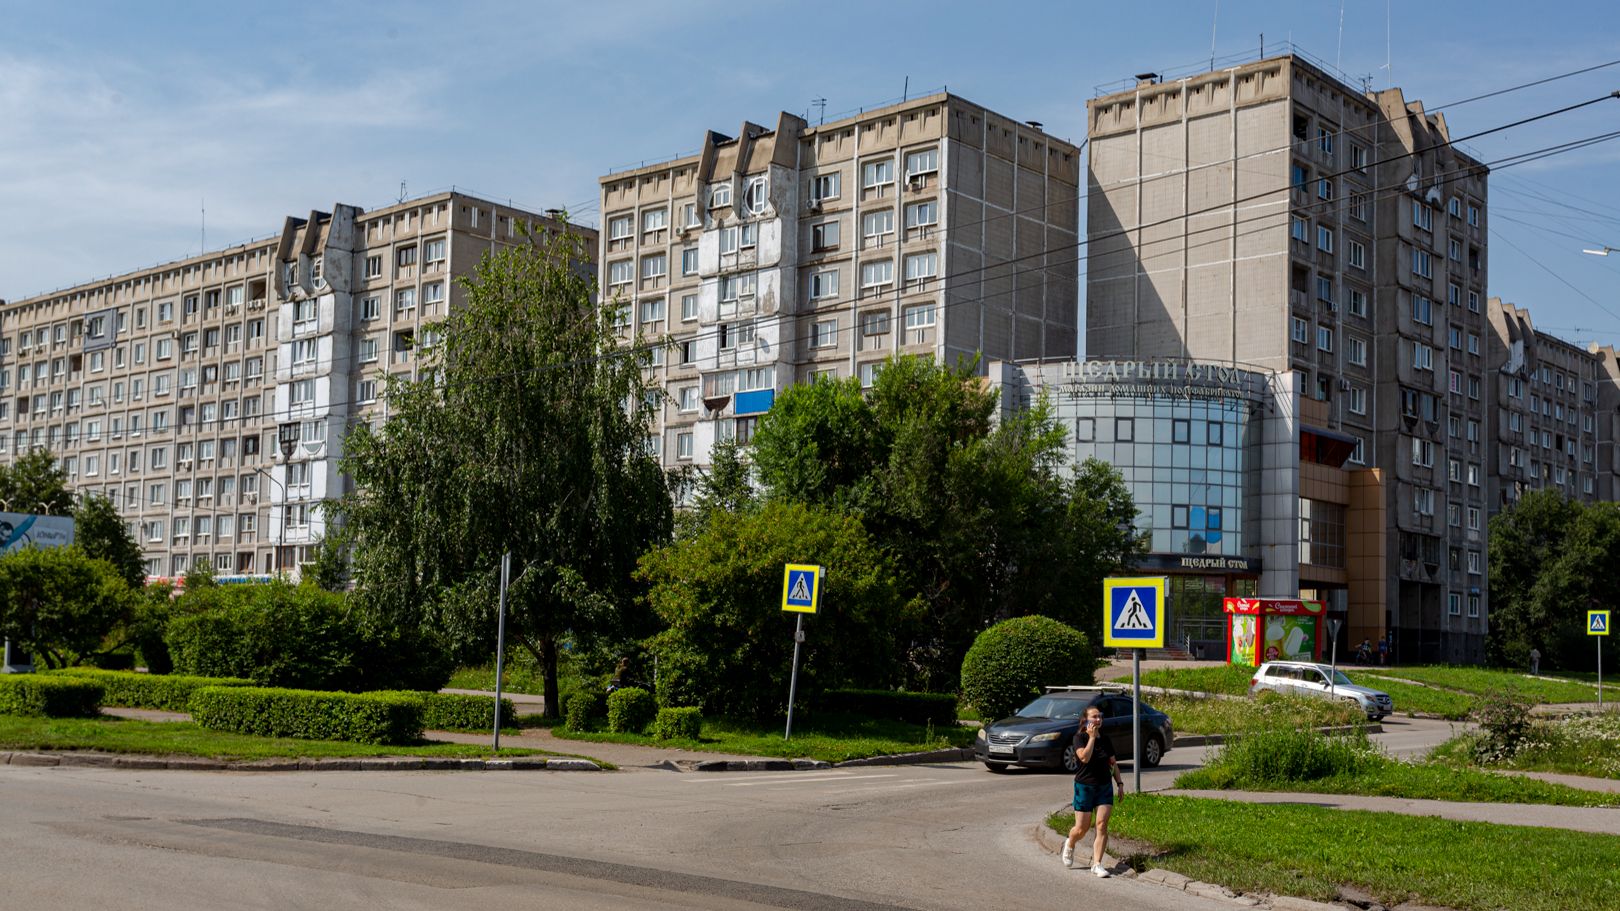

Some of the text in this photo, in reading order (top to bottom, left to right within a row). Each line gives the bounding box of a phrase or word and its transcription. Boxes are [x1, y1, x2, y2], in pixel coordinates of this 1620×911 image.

[1062, 359, 1242, 384] ЩЕДРЫЙ СТОЛ
[1059, 384, 1105, 393] МАГАЗИН
[1109, 384, 1167, 394] ДОМАШНИХ
[1181, 557, 1248, 569] ЩЕДРЫЙ СТОЛ
